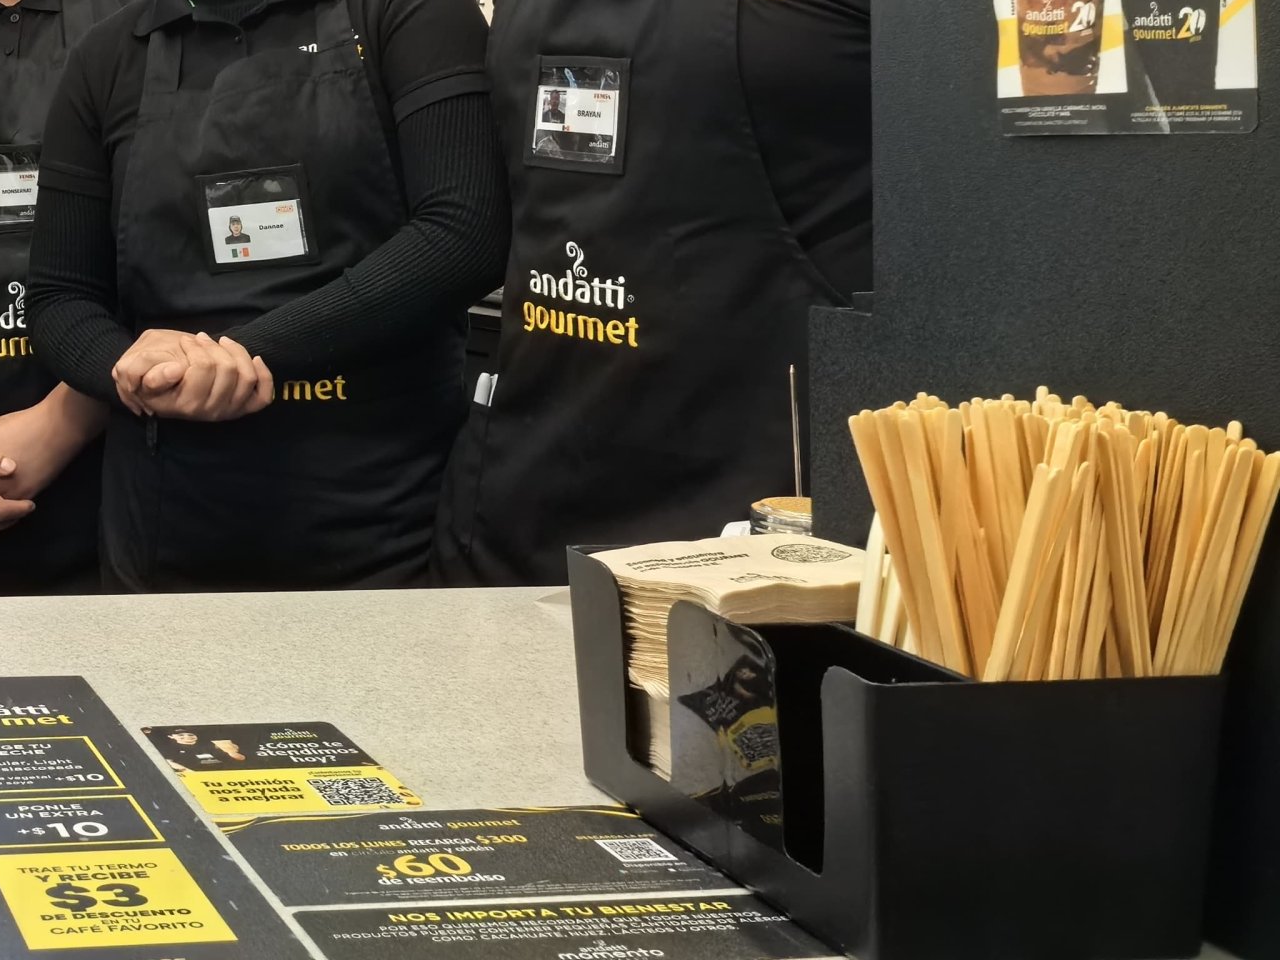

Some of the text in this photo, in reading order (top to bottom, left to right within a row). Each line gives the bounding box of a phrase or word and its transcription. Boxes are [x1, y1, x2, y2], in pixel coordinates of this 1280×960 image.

[1133, 11, 1172, 27] andatti
[1132, 27, 1176, 41] gourmet
[577, 109, 601, 118] BRAYAN
[529, 269, 627, 310] andatti
[523, 301, 639, 348] gourmet
[256, 746, 359, 757] atendimos
[259, 740, 344, 752] ¿Cómo te
[289, 753, 337, 764] hoy?
[227, 777, 295, 788] opinión
[233, 793, 306, 803] mejorar
[245, 785, 301, 798] ayuda
[5, 809, 104, 819] UN EXTRA
[17, 803, 84, 812] PONLE
[281, 834, 528, 851] TODOS LOS LUNES RECARGA $300
[17, 866, 65, 875] TRAE
[97, 862, 158, 871] TERMO
[376, 853, 472, 878] $60
[36, 870, 150, 883] Y RECIBE
[377, 872, 506, 886] de reembolso
[45, 882, 149, 913] $3
[40, 908, 192, 921] DE DESCUENTO
[388, 901, 733, 923] NOS IMPORTA TU BIENESTAR
[50, 920, 204, 935] CAFÉ FAVORITO
